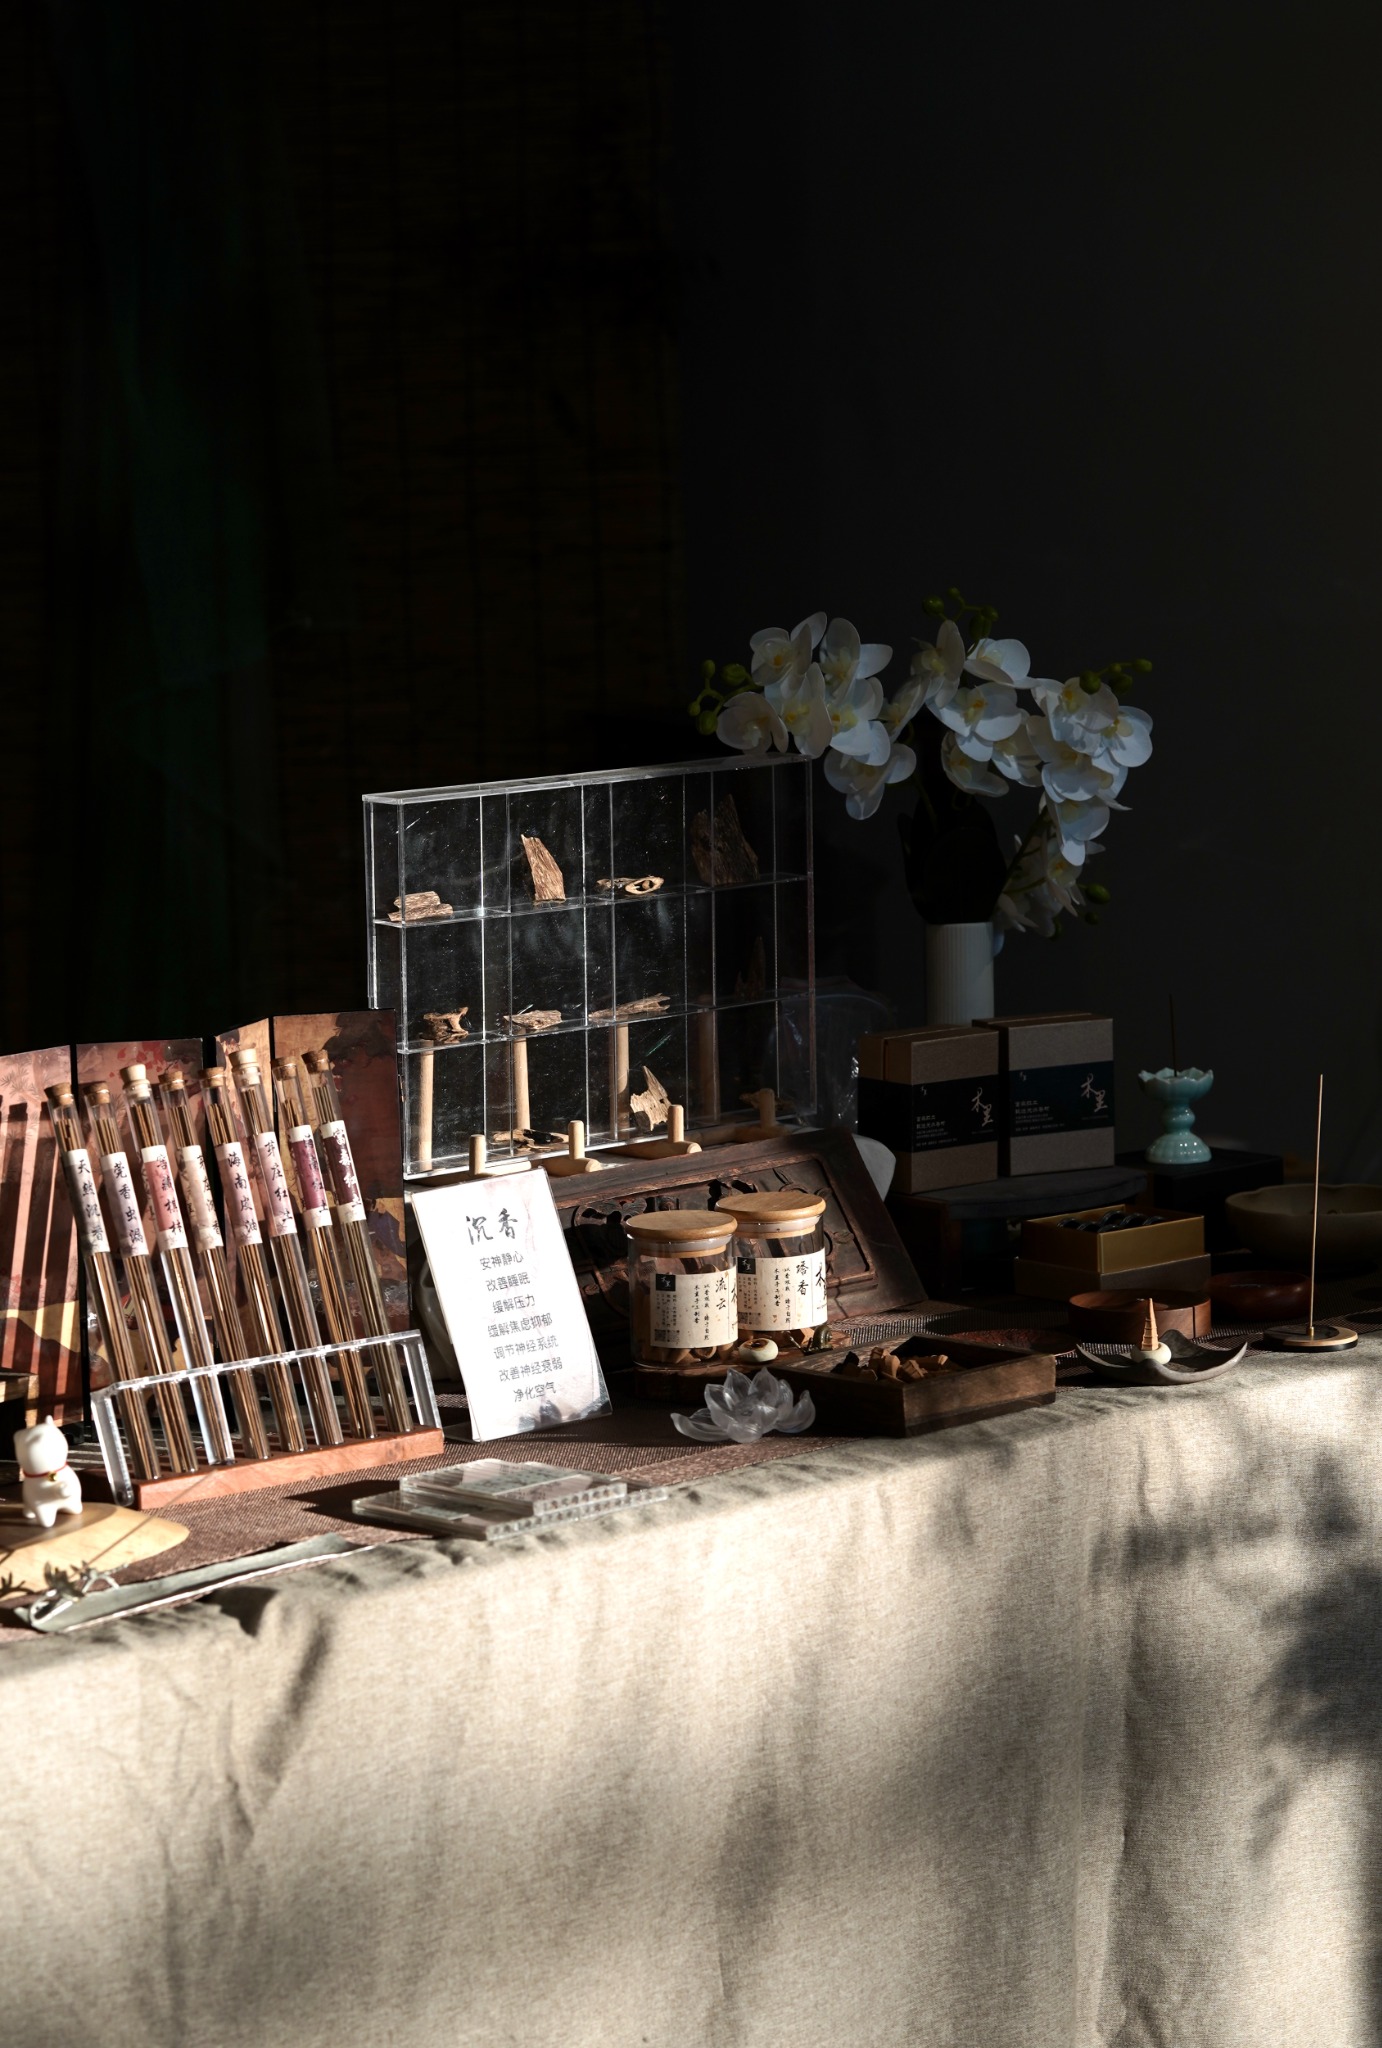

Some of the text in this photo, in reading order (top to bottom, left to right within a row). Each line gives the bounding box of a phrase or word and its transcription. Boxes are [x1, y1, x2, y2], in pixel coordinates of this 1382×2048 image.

[227, 1151, 257, 1233] 海南皮油
[264, 1140, 293, 1222] 芽庄红土
[77, 1159, 104, 1241] 天然沉香
[465, 1208, 519, 1245] 沉香
[480, 1250, 524, 1271] 安神静心
[486, 1272, 531, 1293] 改善睡眠
[795, 1260, 809, 1296] 塔香
[492, 1294, 536, 1314] 缓解压力
[715, 1277, 727, 1310] 流云
[487, 1313, 553, 1339] 缓解焦虑抑郁
[493, 1335, 559, 1360] 调节神经系统
[499, 1357, 563, 1382] 改善神经衰弱
[513, 1382, 557, 1403] 净化空气
